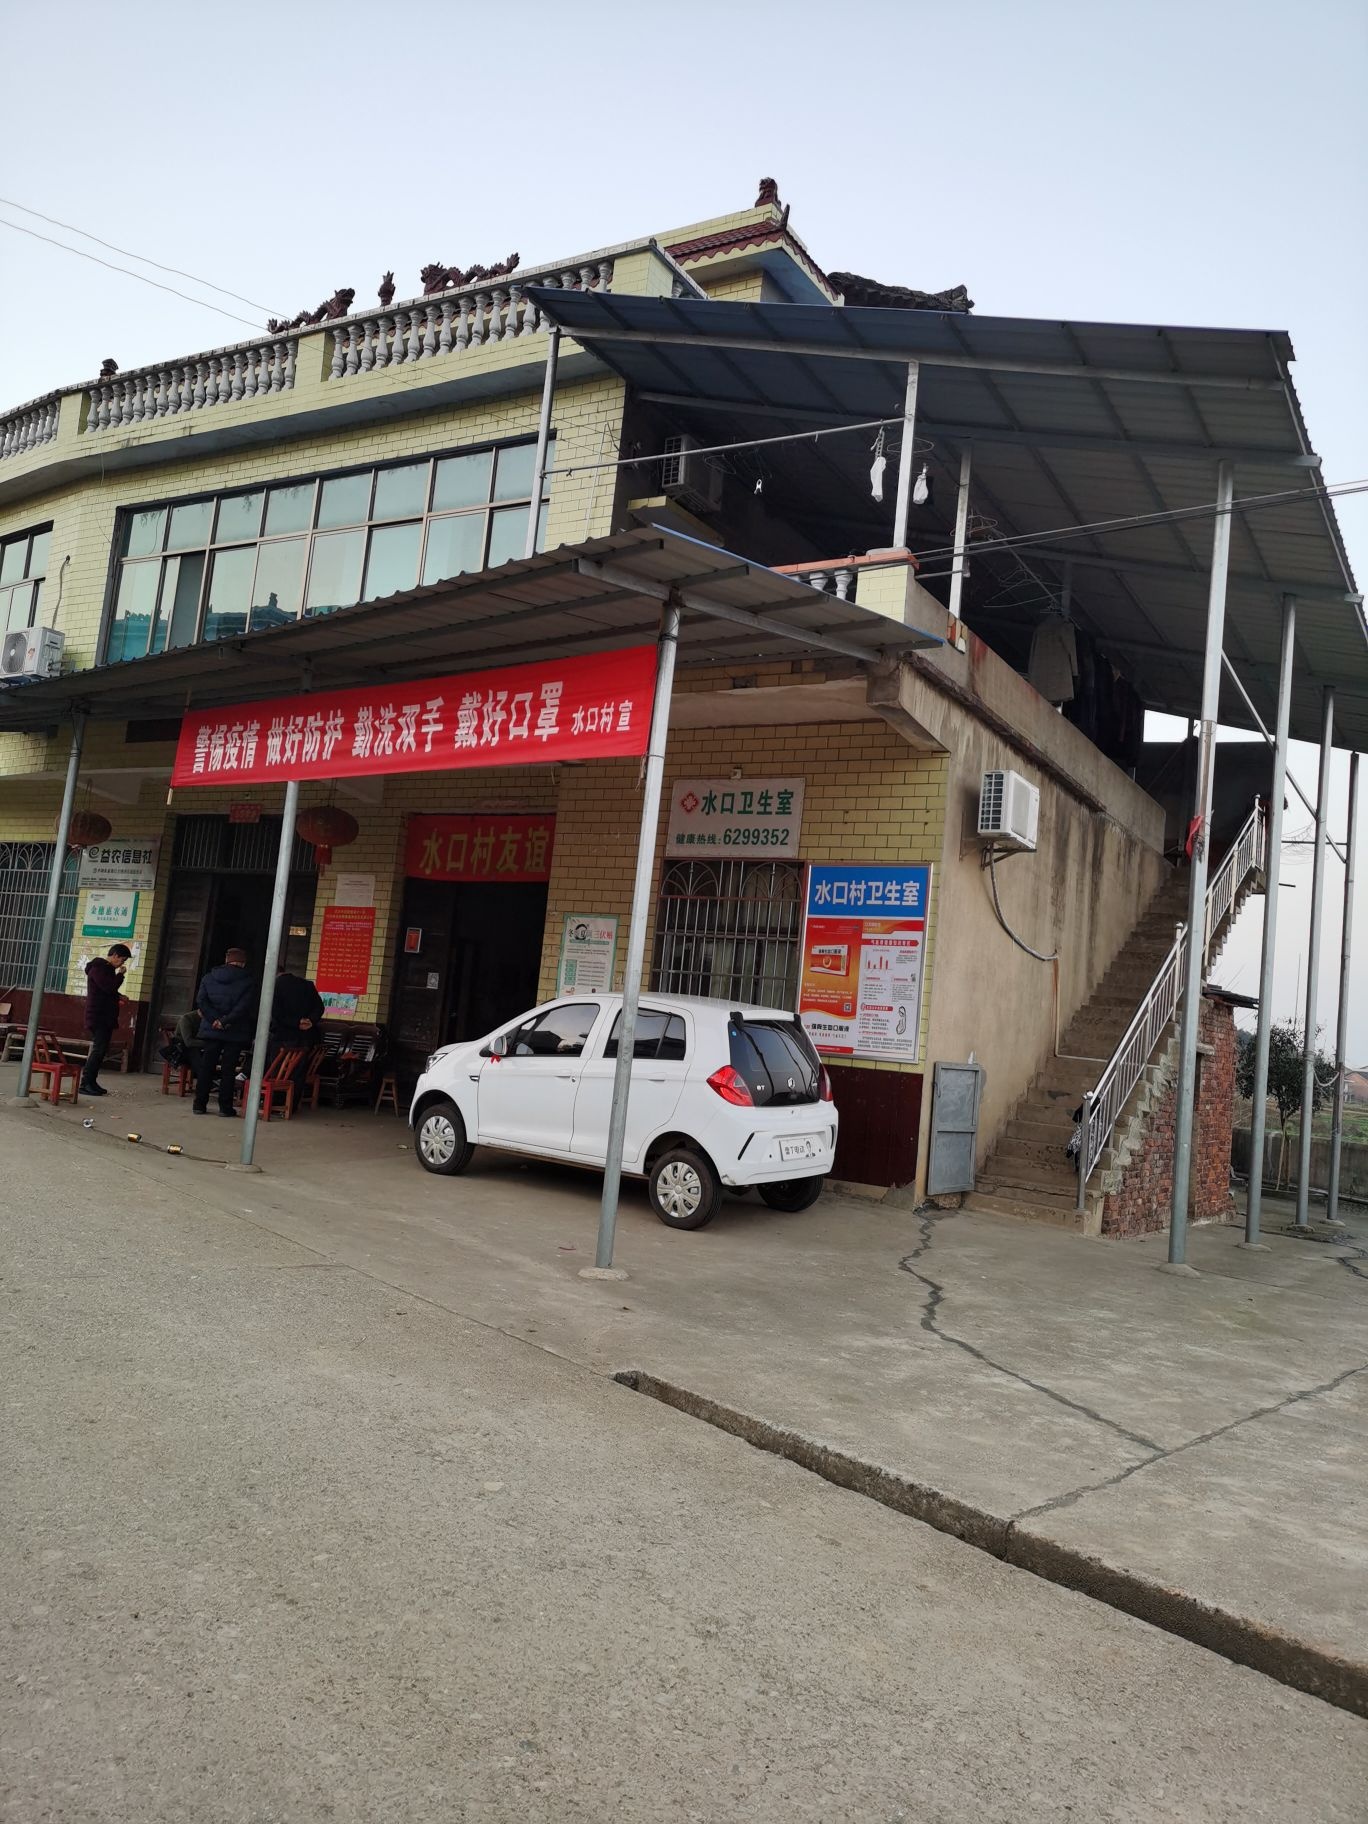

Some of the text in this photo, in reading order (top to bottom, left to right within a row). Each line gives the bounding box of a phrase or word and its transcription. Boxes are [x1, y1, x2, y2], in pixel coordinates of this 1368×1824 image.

[192, 681, 633, 774] 警惕疫情 做好防护 勤洗双手 戴好口罩 水口村宣
[701, 788, 794, 816] 水口卫生室
[101, 849, 153, 864] 益农信息社
[419, 825, 551, 876] 水口村友谊
[814, 880, 920, 906] 水口村卫生室
